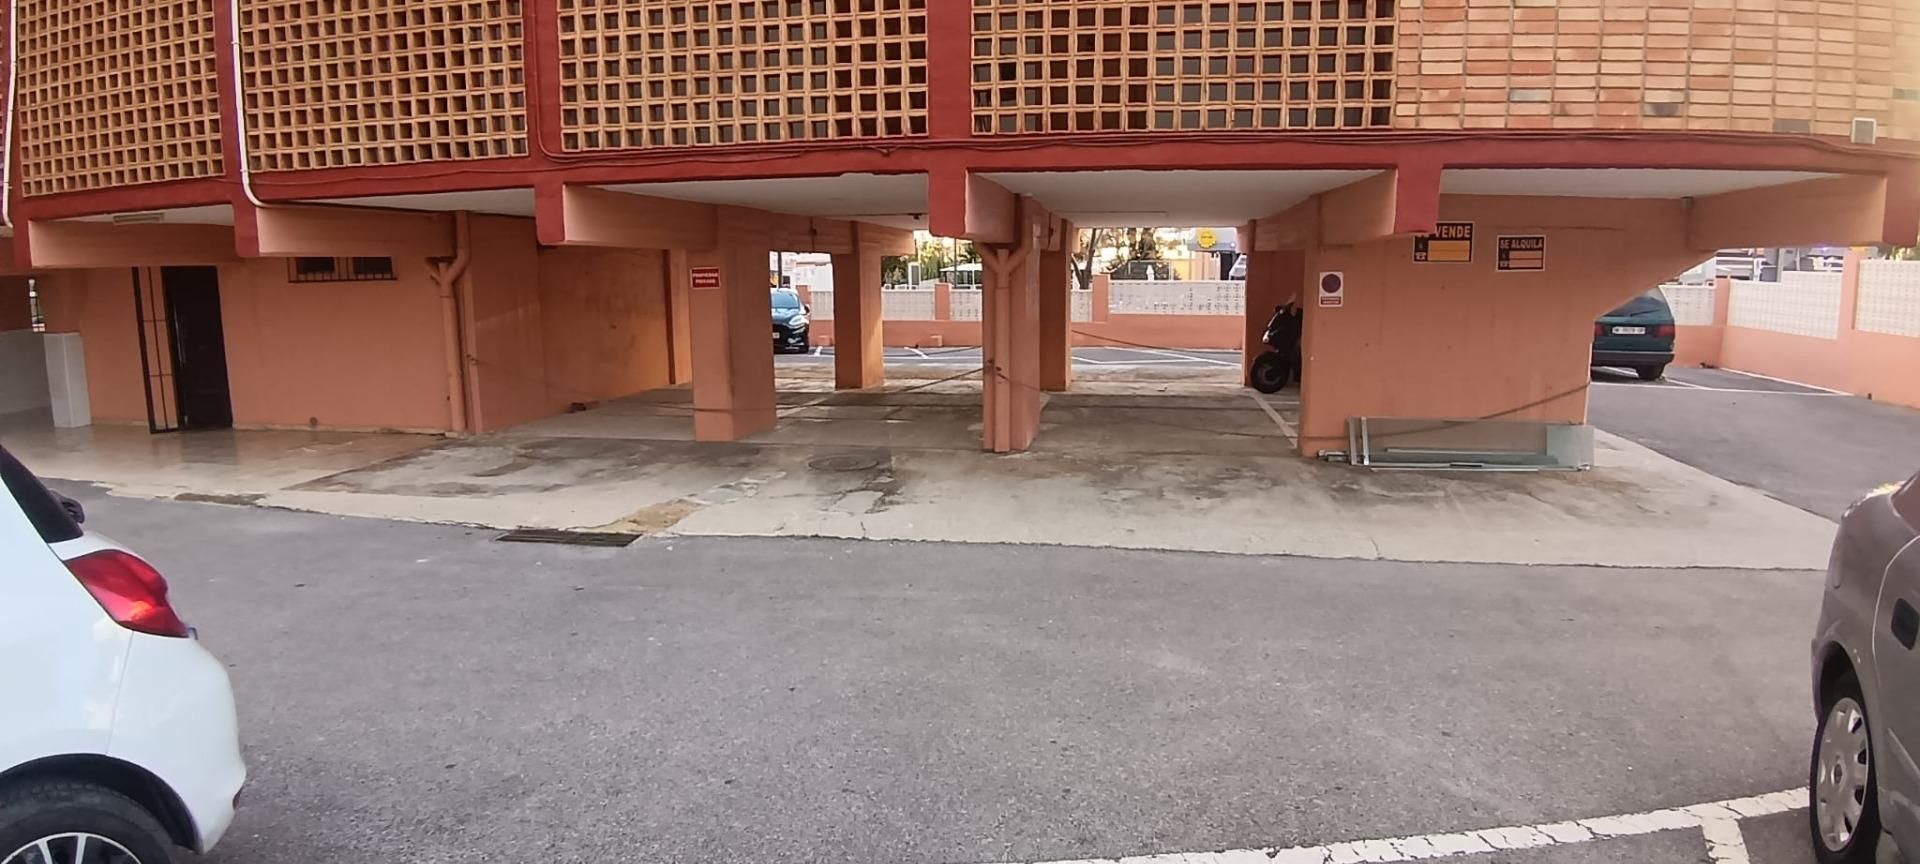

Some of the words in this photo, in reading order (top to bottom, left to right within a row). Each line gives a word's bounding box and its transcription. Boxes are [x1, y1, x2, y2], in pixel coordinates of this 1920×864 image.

[1434, 225, 1471, 238] VENDE
[1500, 239, 1510, 249] SE
[1511, 239, 1543, 249] ALQUILA
